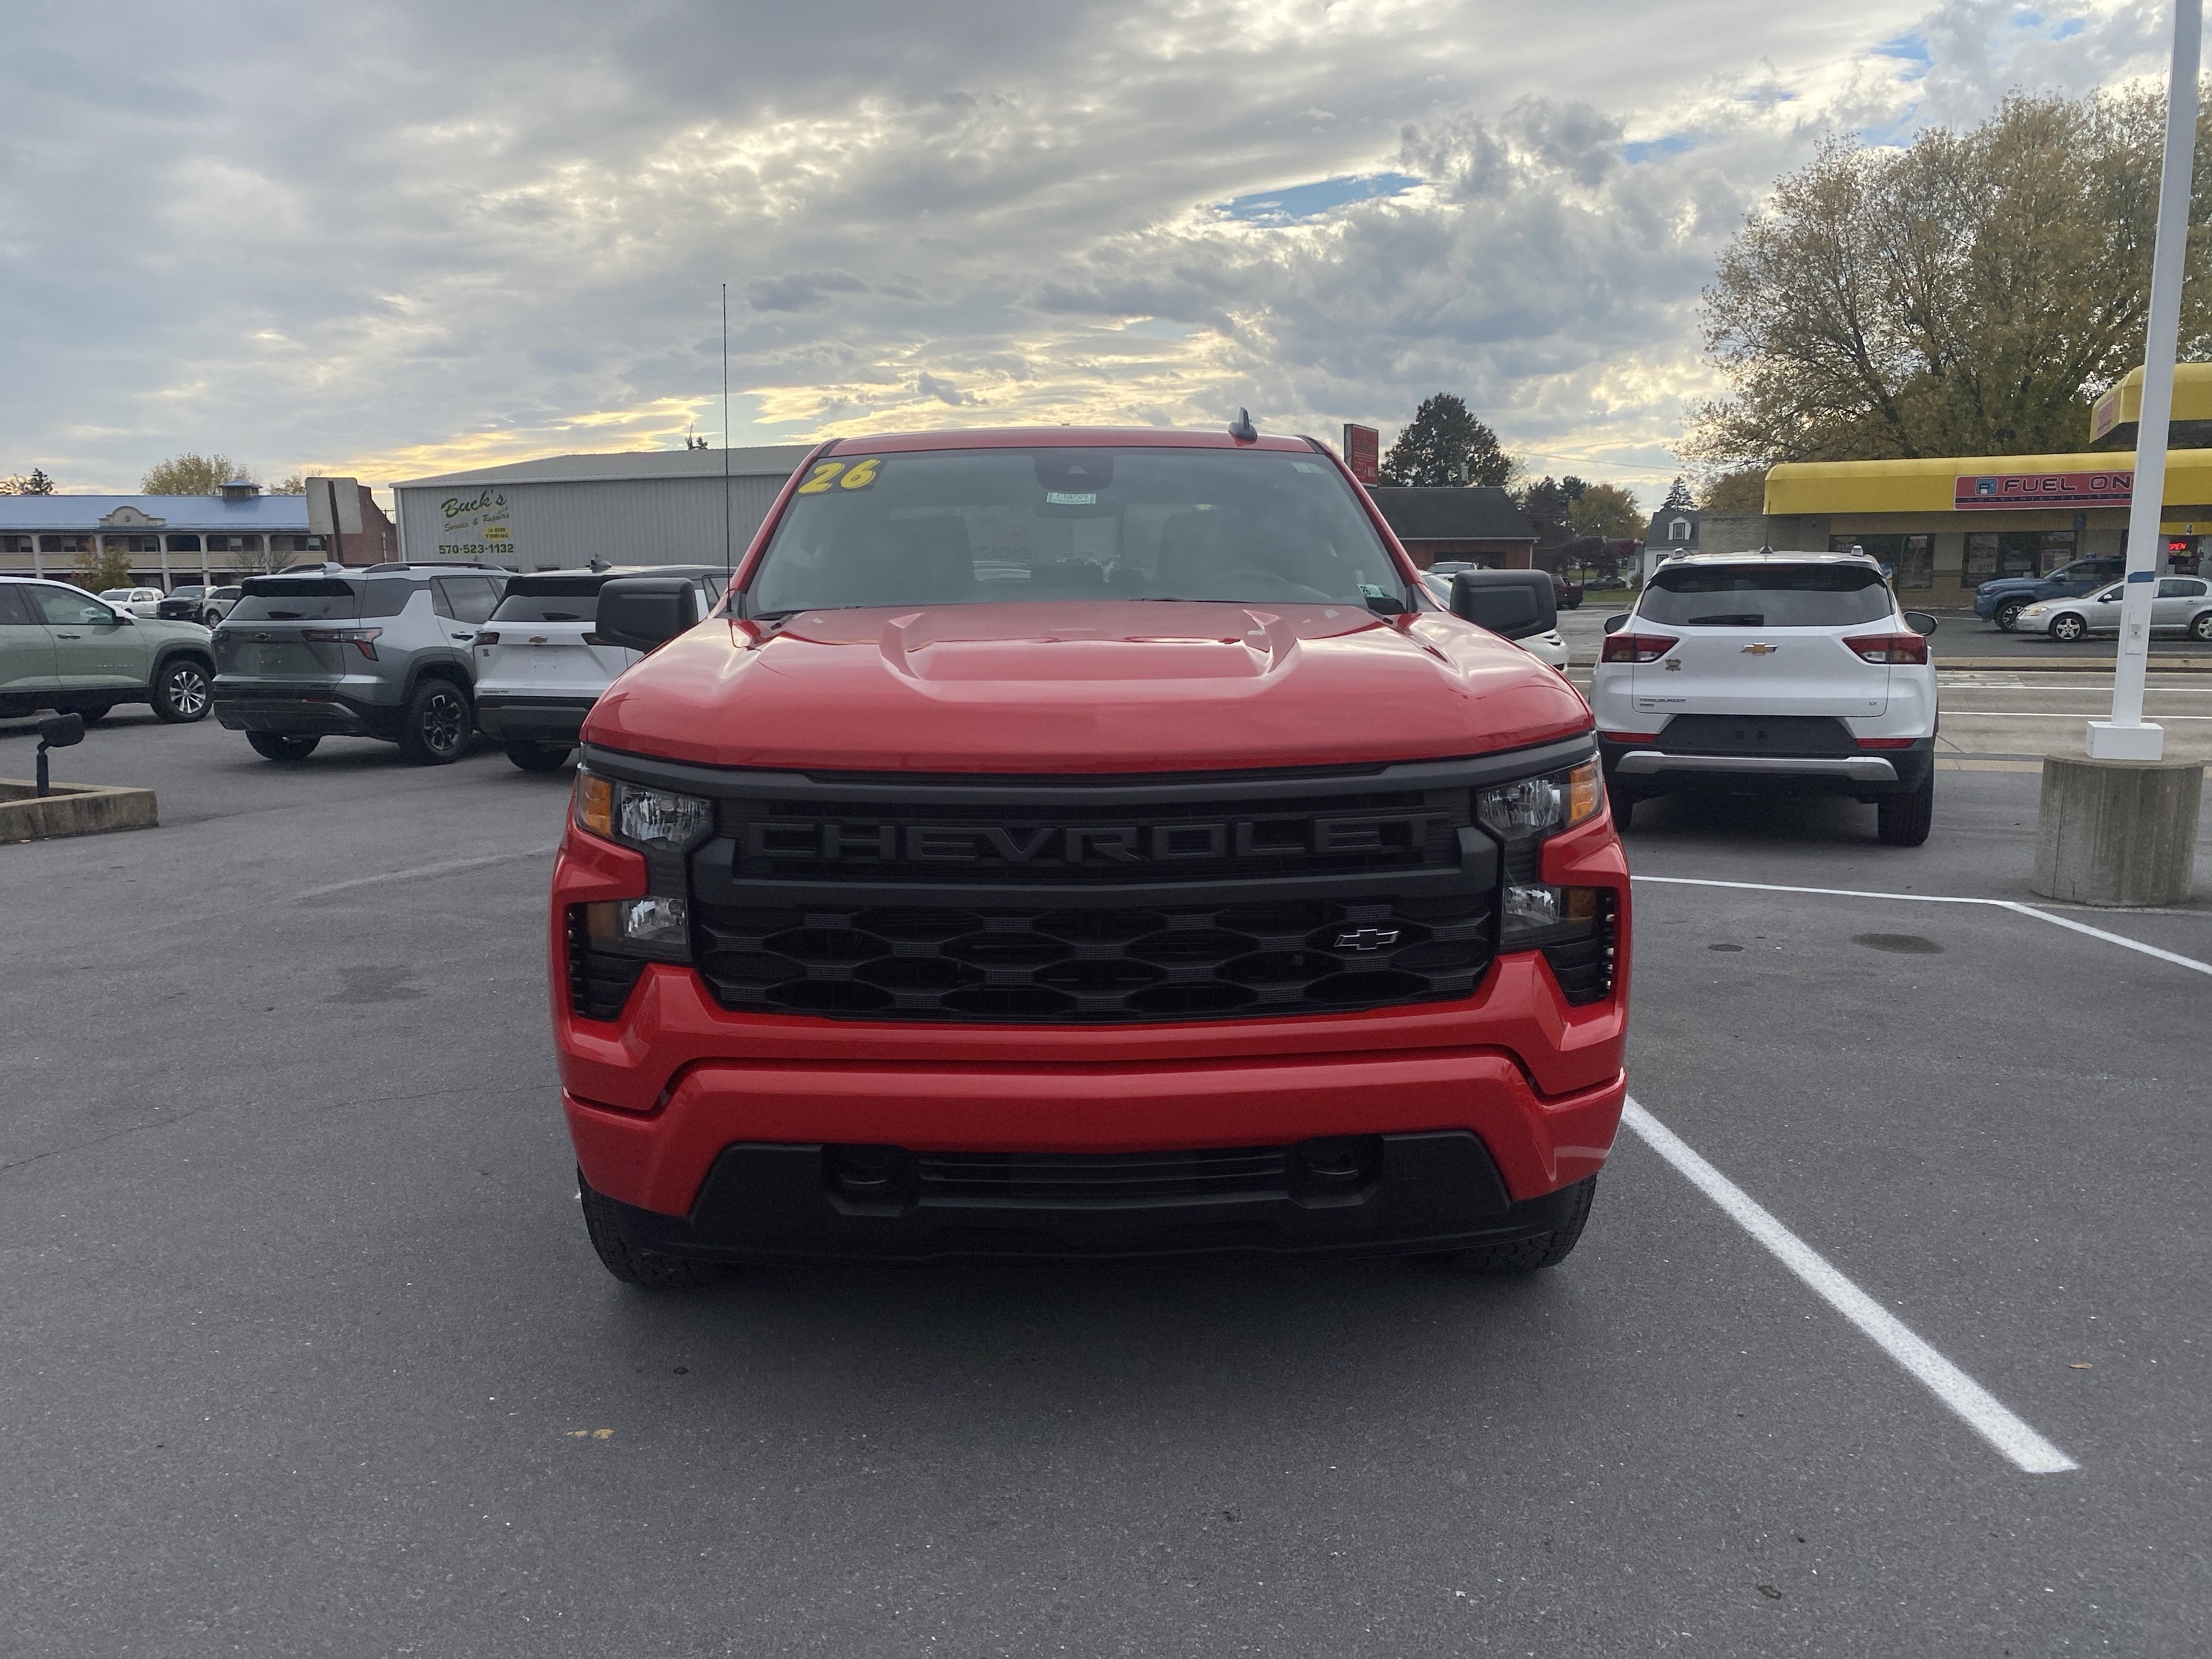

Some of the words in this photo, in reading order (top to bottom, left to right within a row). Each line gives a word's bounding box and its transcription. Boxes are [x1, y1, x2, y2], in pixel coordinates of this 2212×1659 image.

[798, 458, 881, 494] 26
[2003, 477, 2076, 493] FUEL
[2090, 475, 2131, 491] ON
[441, 489, 507, 518] Buck's
[2186, 524, 2193, 534] 4
[439, 544, 515, 555] 570-523-1132
[1360, 585, 1372, 595] 26
[746, 811, 1451, 863] CHEVROLET
